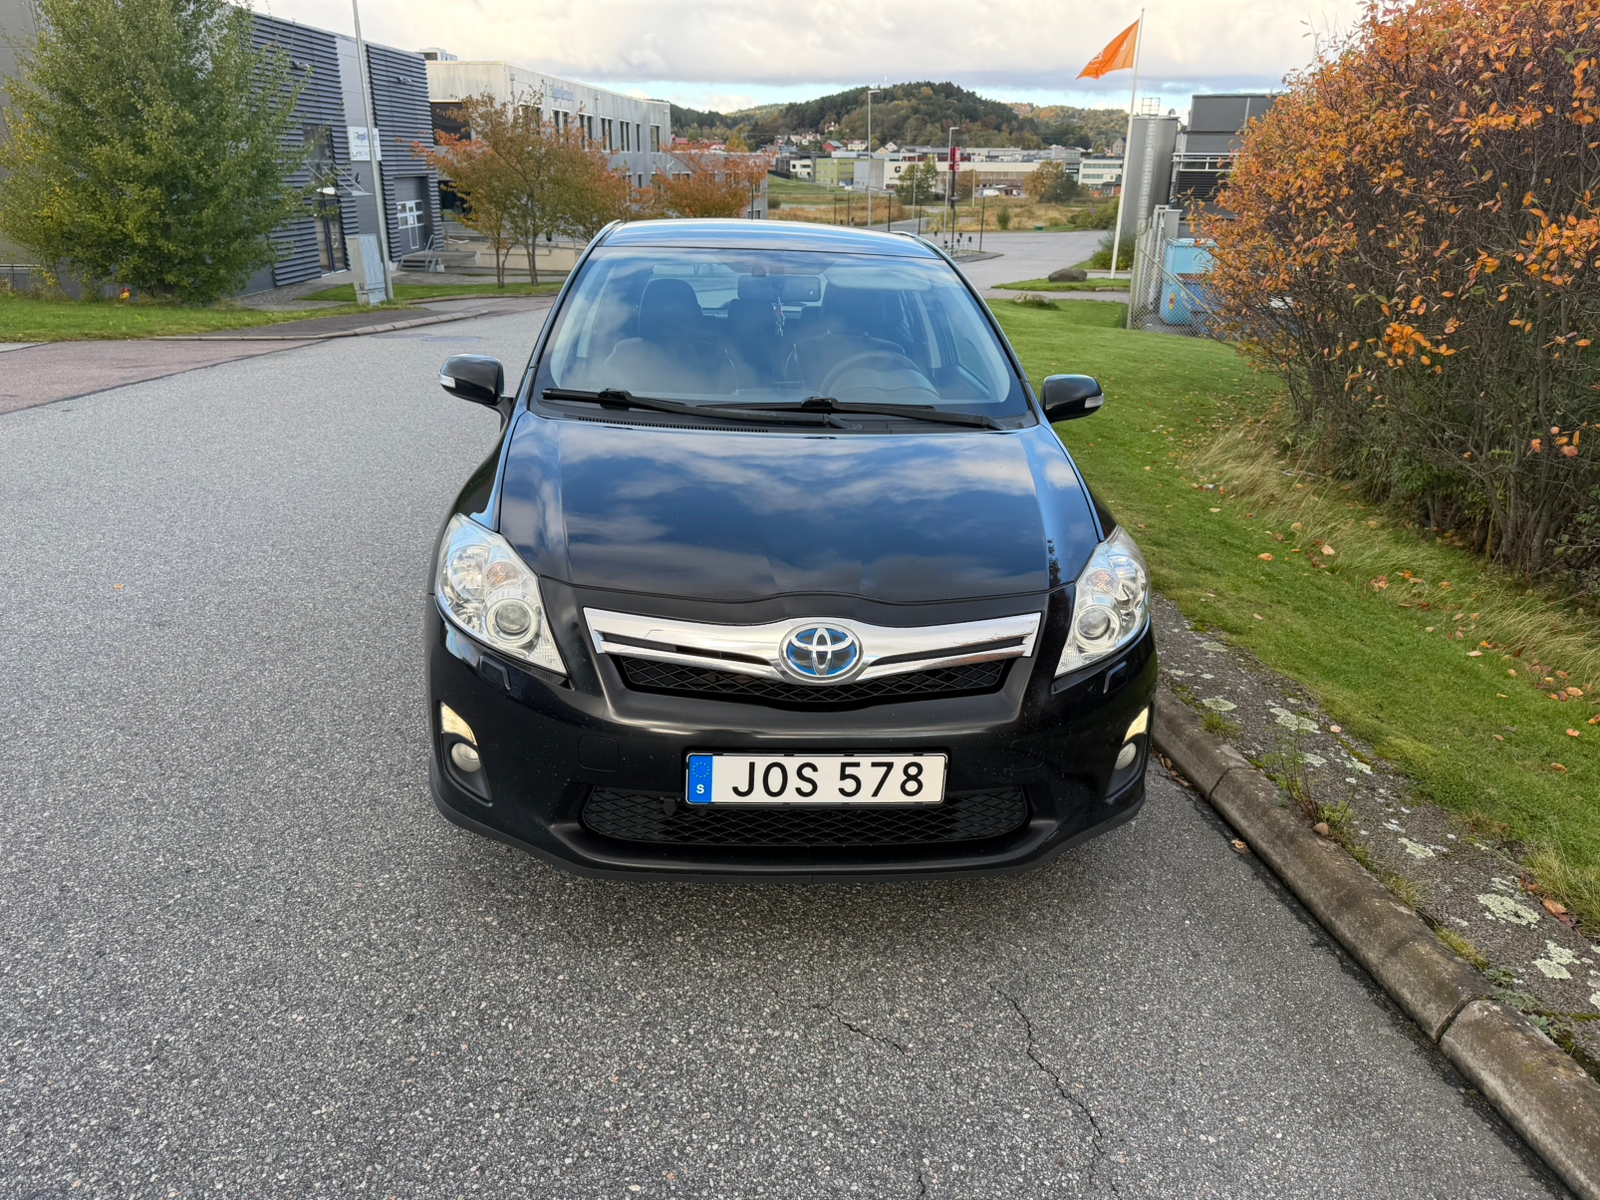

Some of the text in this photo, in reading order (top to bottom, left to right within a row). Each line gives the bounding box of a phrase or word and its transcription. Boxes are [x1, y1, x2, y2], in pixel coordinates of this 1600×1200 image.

[695, 783, 706, 795] S
[731, 761, 924, 798] JOS 578
